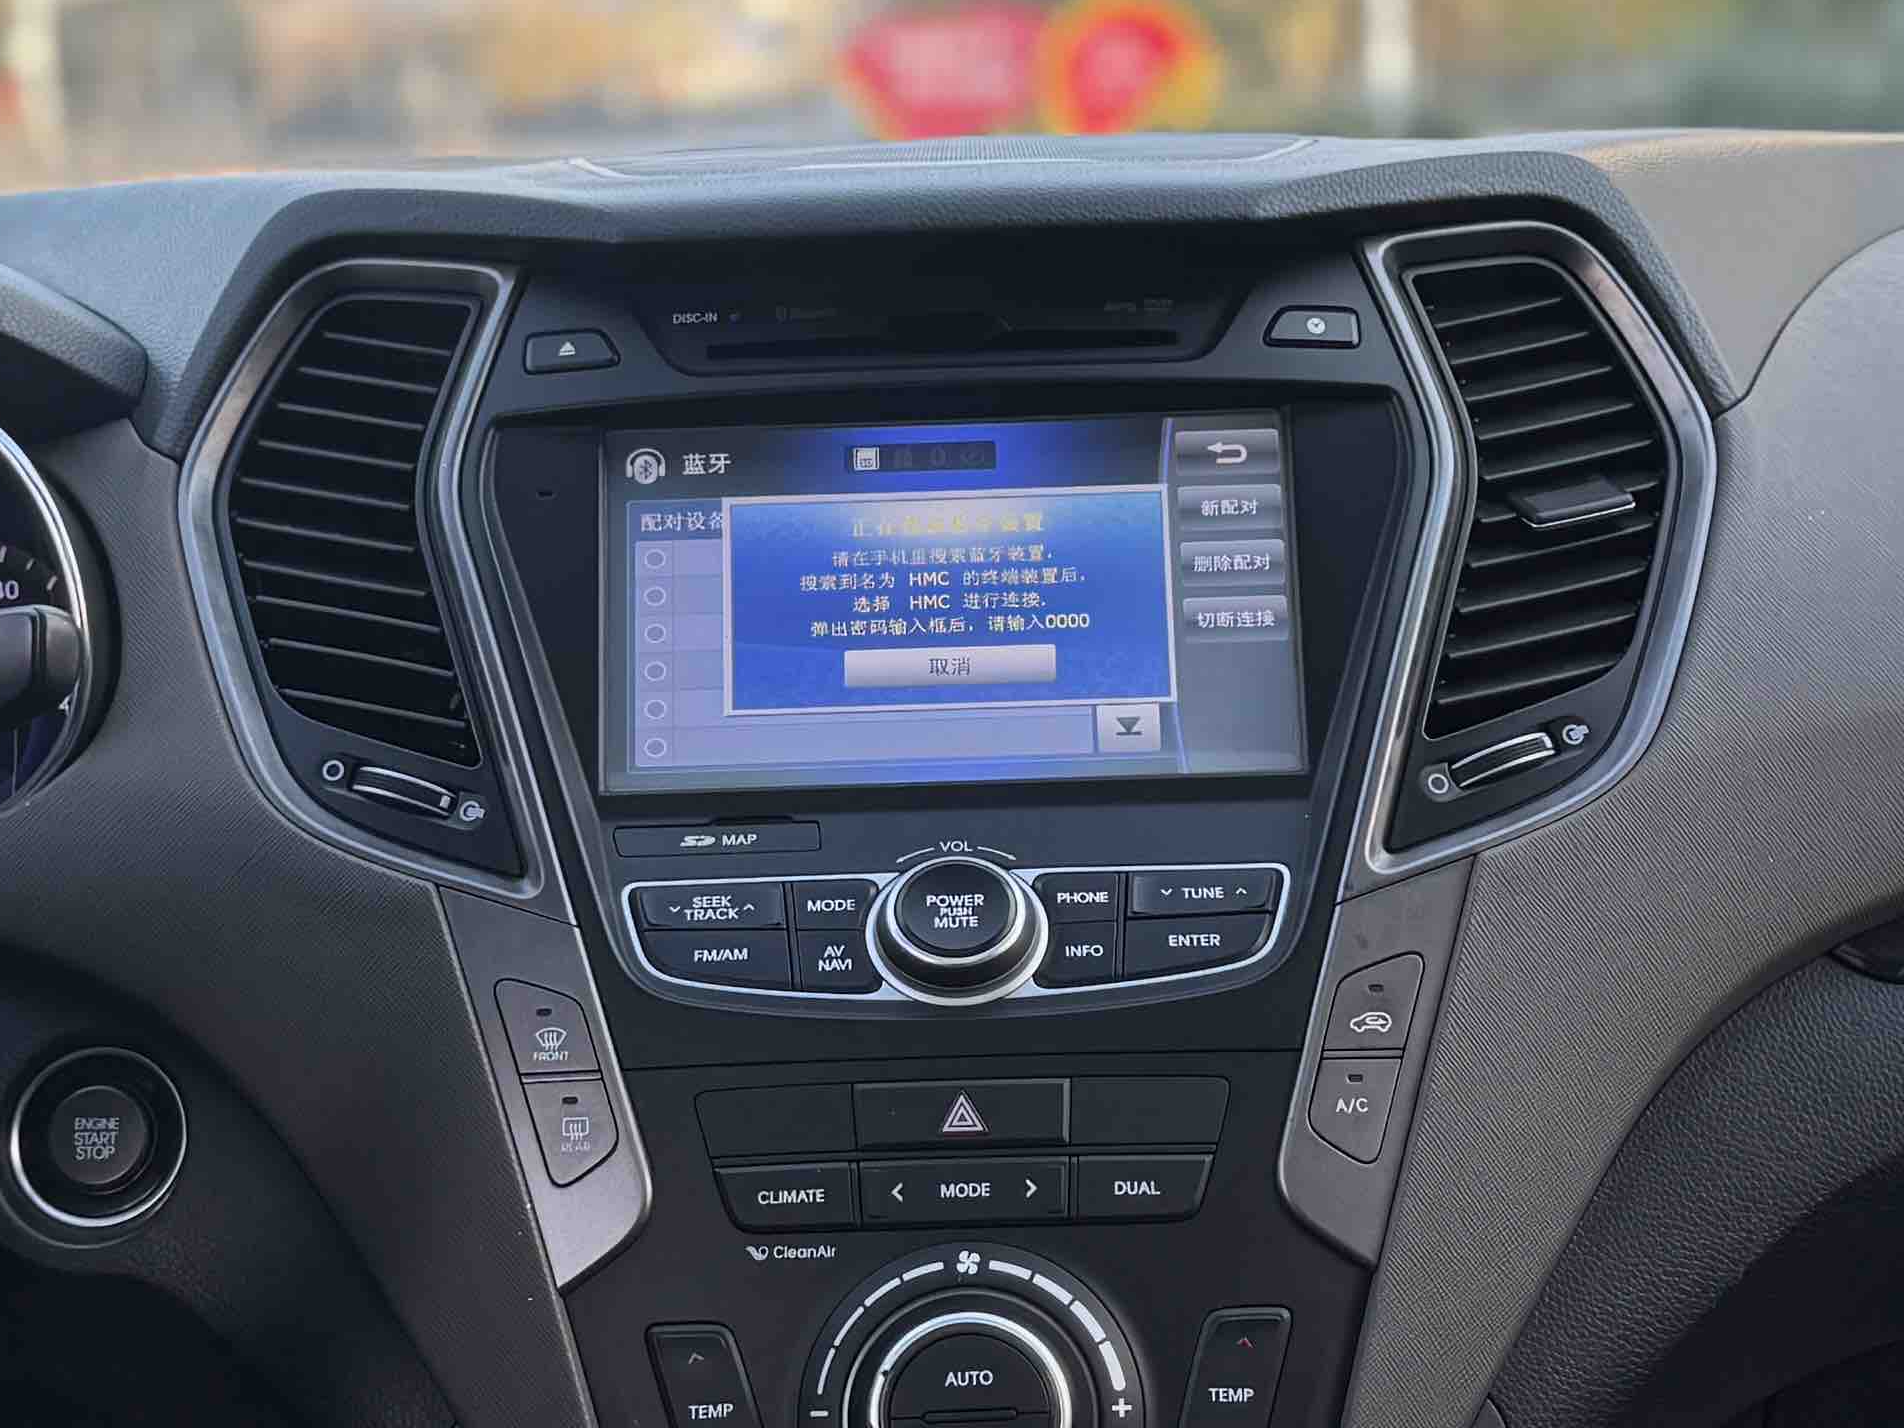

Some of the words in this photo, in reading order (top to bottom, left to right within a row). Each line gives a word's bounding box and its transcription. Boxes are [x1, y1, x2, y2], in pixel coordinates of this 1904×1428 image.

[672, 311, 718, 324] DISC-IN
[682, 453, 731, 475] 蓝牙
[1201, 499, 1258, 517] 新配对
[1194, 553, 1270, 573] 删除配对
[800, 572, 895, 592] 搜索到名为
[908, 571, 950, 587] HMC
[853, 596, 890, 613] 选择
[910, 594, 950, 610] HMC
[1197, 609, 1277, 629] 切断连接
[929, 658, 971, 677] 取消
[721, 833, 758, 847] MAP
[939, 840, 973, 853] VOL
[925, 893, 985, 908] POWER
[1056, 891, 1110, 905] PHONE
[1181, 886, 1225, 901] TUNE
[691, 895, 733, 909] SEEK
[807, 899, 856, 913] MODE
[684, 907, 740, 921] TRACK
[939, 907, 973, 917] PUSH
[933, 916, 979, 930] MUTE
[1167, 933, 1221, 948] ENTER
[693, 947, 749, 963] FM/AM
[823, 945, 845, 959] AV
[1064, 944, 1104, 958] INFO
[818, 958, 853, 972] NAVI
[533, 1051, 569, 1062] FRONT
[1335, 1097, 1370, 1114] A/C
[74, 1116, 120, 1131] ENGINE
[74, 1131, 117, 1146] START
[75, 1146, 116, 1160] STOP
[939, 1182, 992, 1199] MODE
[1113, 1180, 1161, 1197] DUAL
[757, 1188, 826, 1205] CLIMATE
[772, 1244, 836, 1261] CleanAir
[944, 1368, 994, 1388] AUTO
[1208, 1385, 1255, 1405] TEMP
[688, 1403, 734, 1421] TEMP
